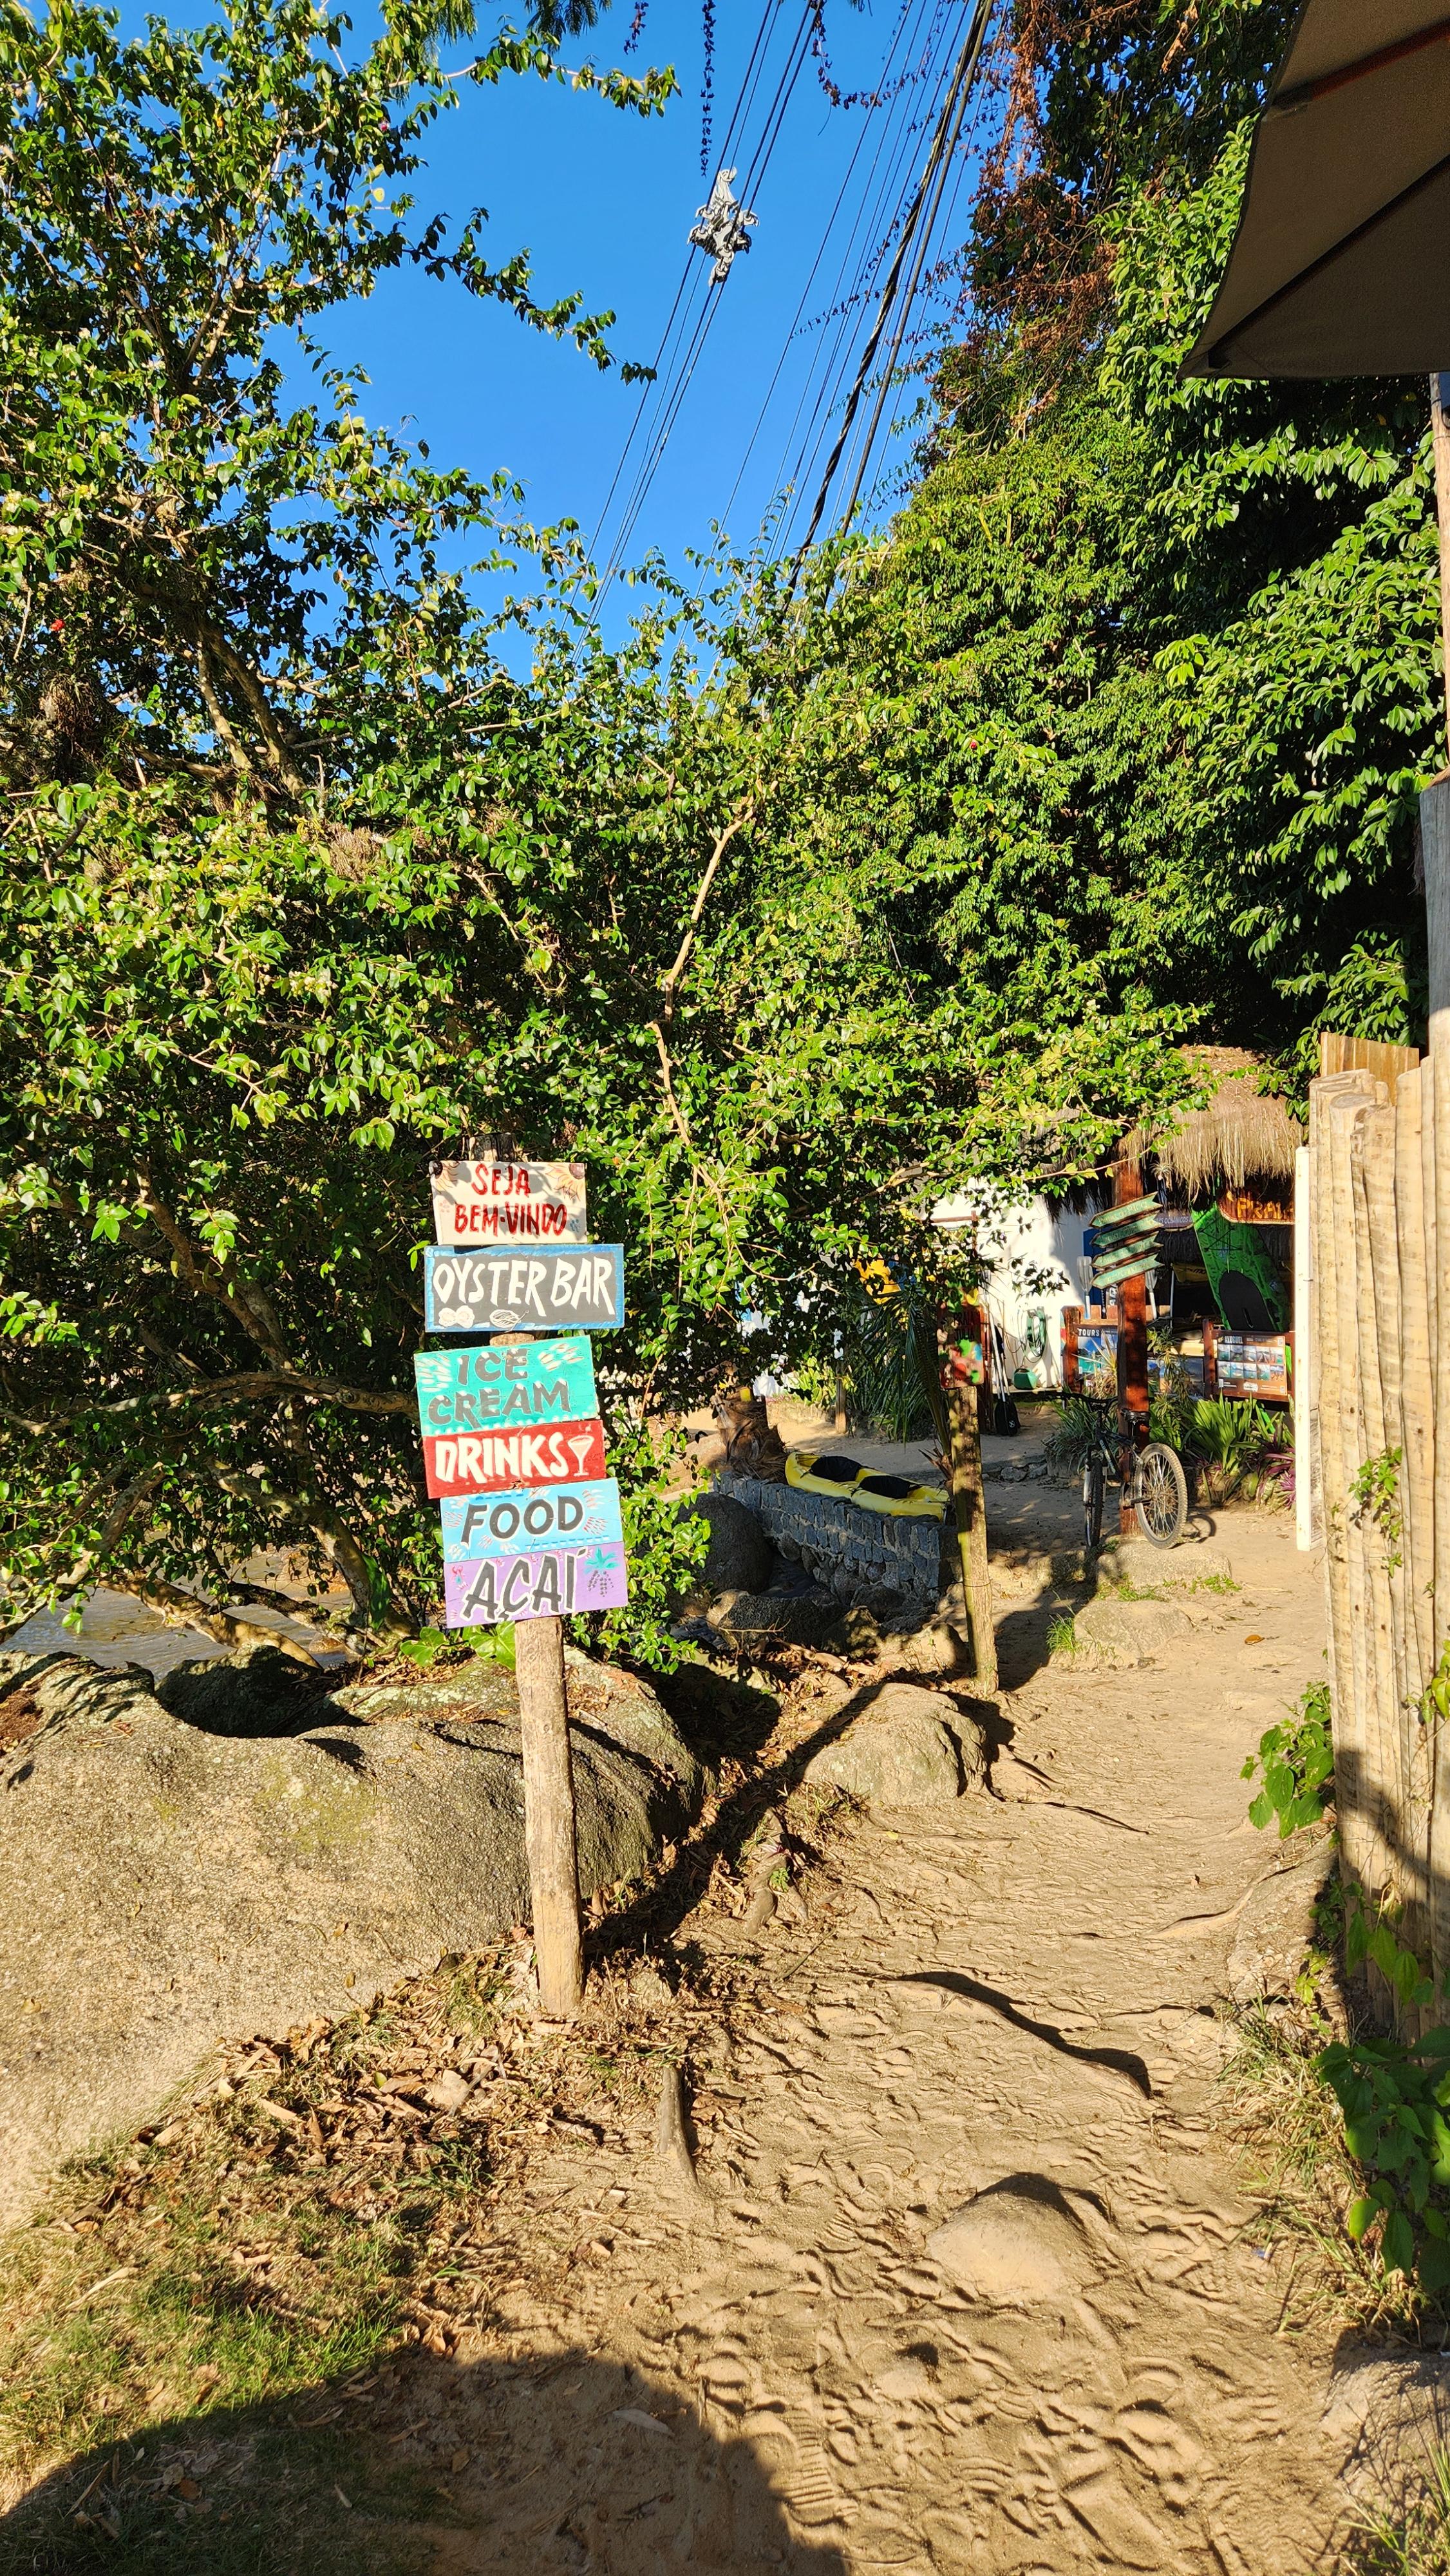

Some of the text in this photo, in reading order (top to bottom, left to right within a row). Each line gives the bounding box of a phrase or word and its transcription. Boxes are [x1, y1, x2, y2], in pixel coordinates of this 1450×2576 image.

[471, 1163, 531, 1198] SEJA
[453, 1201, 567, 1236] BEM-VINDO
[433, 1256, 616, 1317] OYSTER BAR
[1078, 1329, 1100, 1337] TOURS
[457, 1348, 528, 1386] ICE
[428, 1378, 572, 1429] CREAM
[435, 1432, 570, 1484] DRINKS
[460, 1495, 584, 1547] FOOD
[460, 1548, 588, 1622] AÇAÍ
